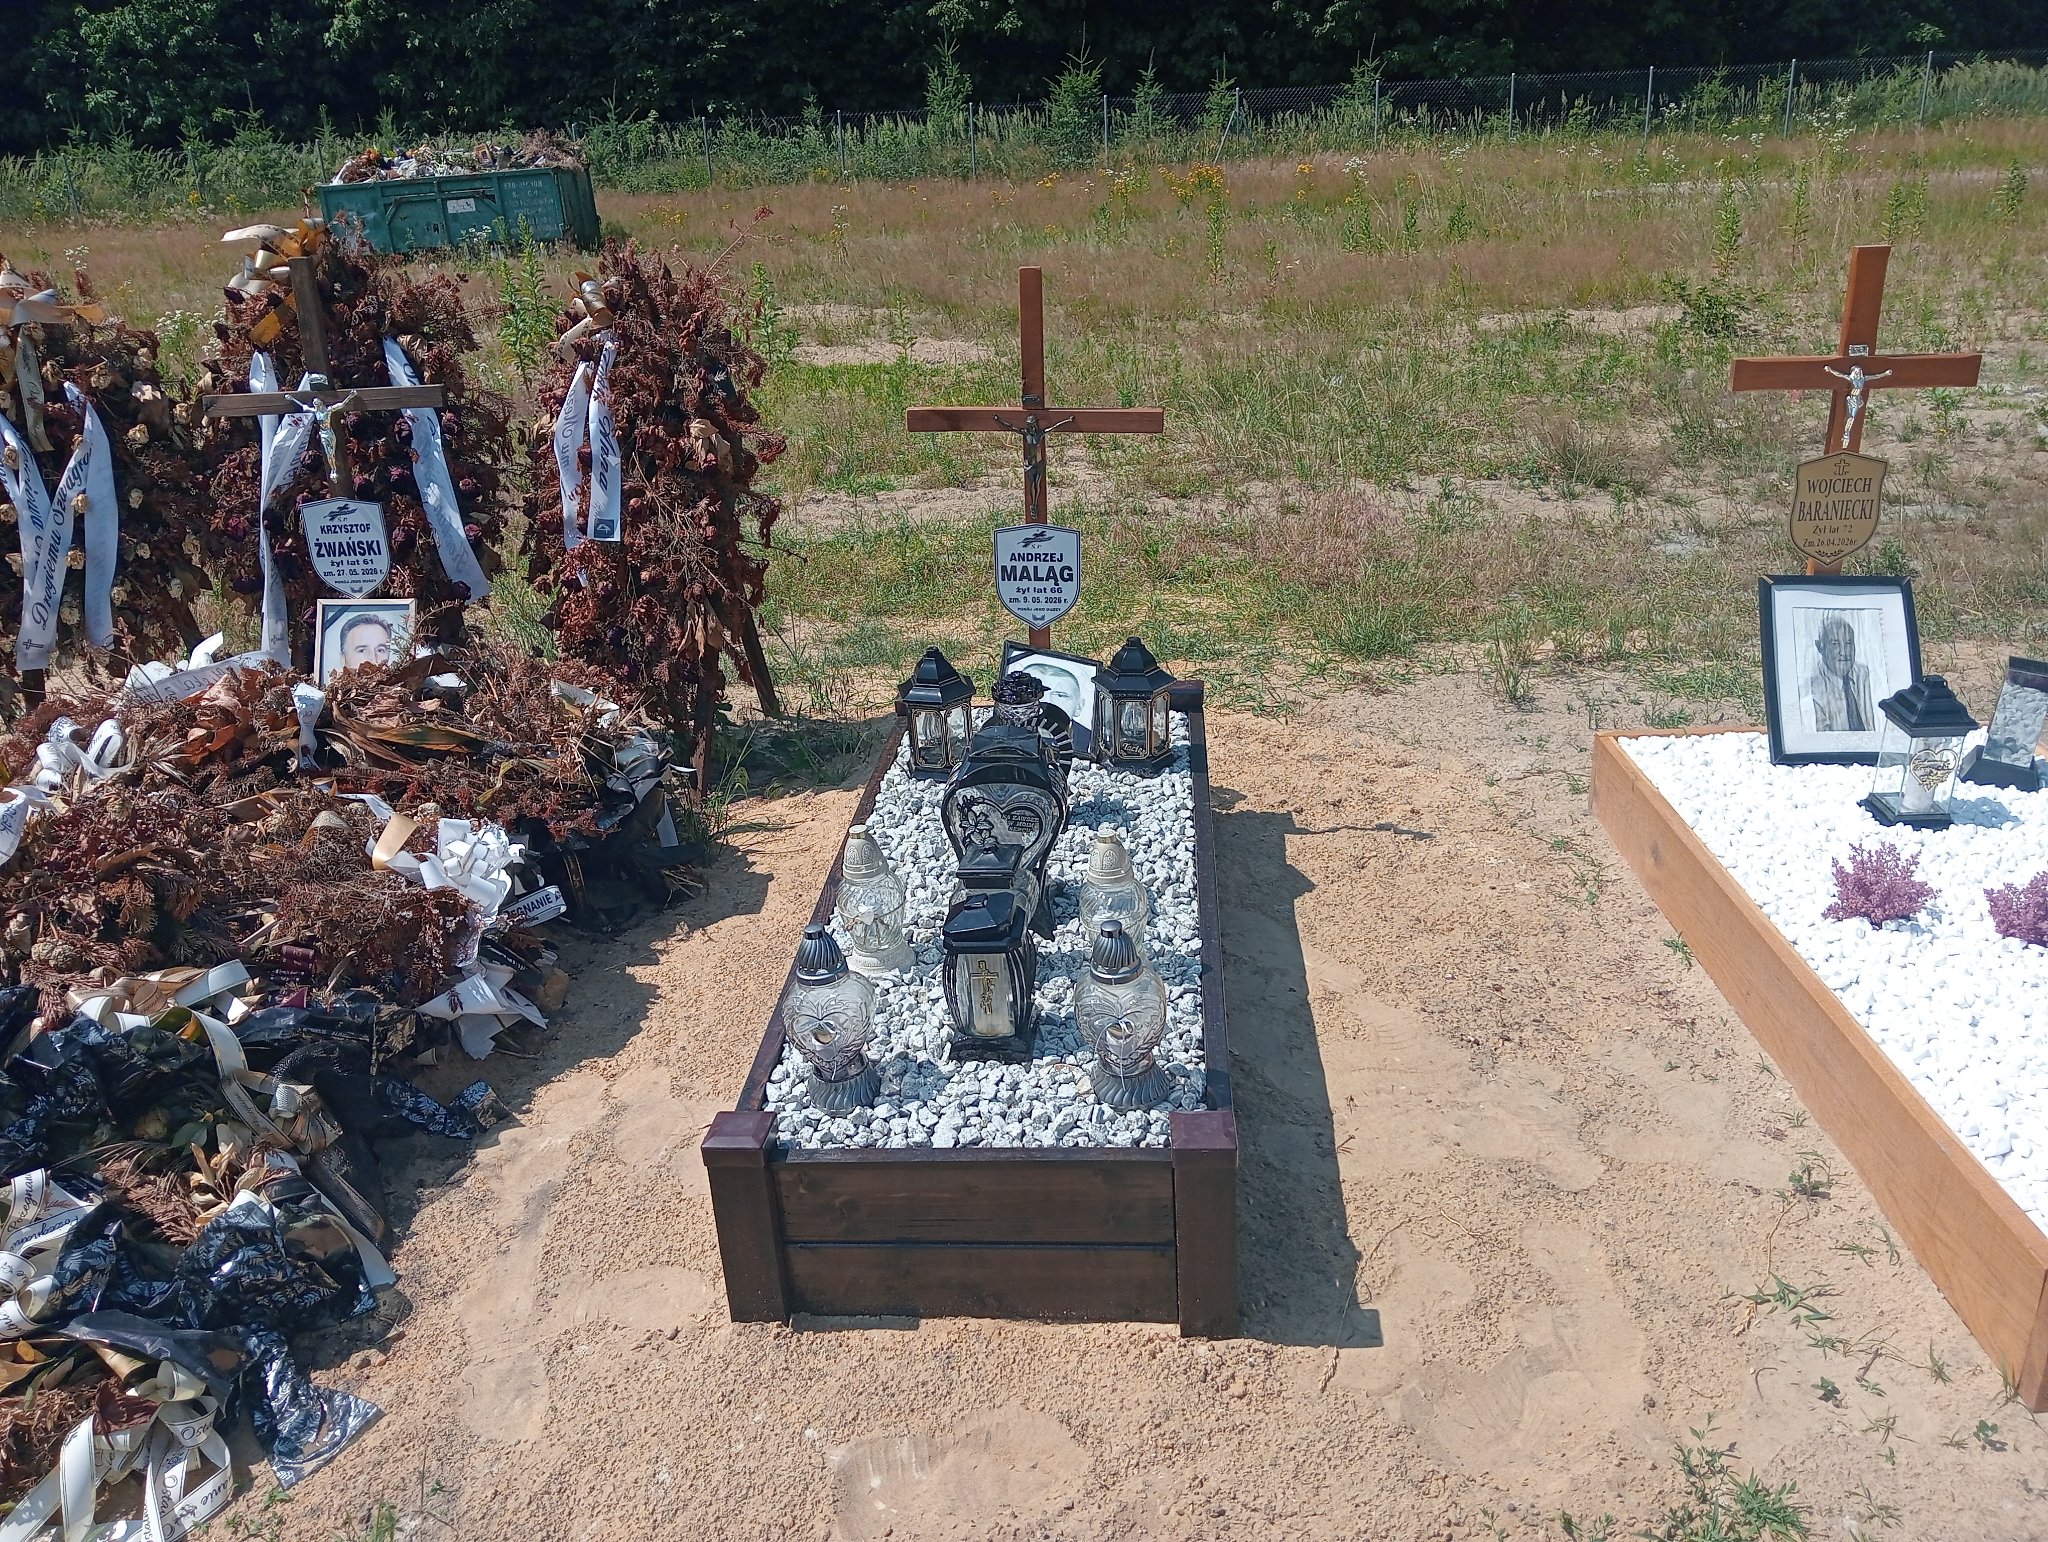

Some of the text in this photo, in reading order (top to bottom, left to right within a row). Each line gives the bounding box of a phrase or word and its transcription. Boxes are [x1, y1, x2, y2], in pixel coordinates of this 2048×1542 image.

[1808, 477, 1873, 497] WOJCIECH
[1797, 499, 1875, 522] BARANIECKI
[320, 523, 371, 535] KRZYSZTOF
[1829, 524, 1839, 533] lat
[31, 449, 92, 631] Drogiemu Szwagro
[313, 537, 383, 558] ŻWAŃSKI
[1009, 552, 1064, 562] ANDRZEJ
[1000, 564, 1074, 586] MALĄG
[1016, 586, 1030, 595] żył
[1033, 586, 1047, 594] lat
